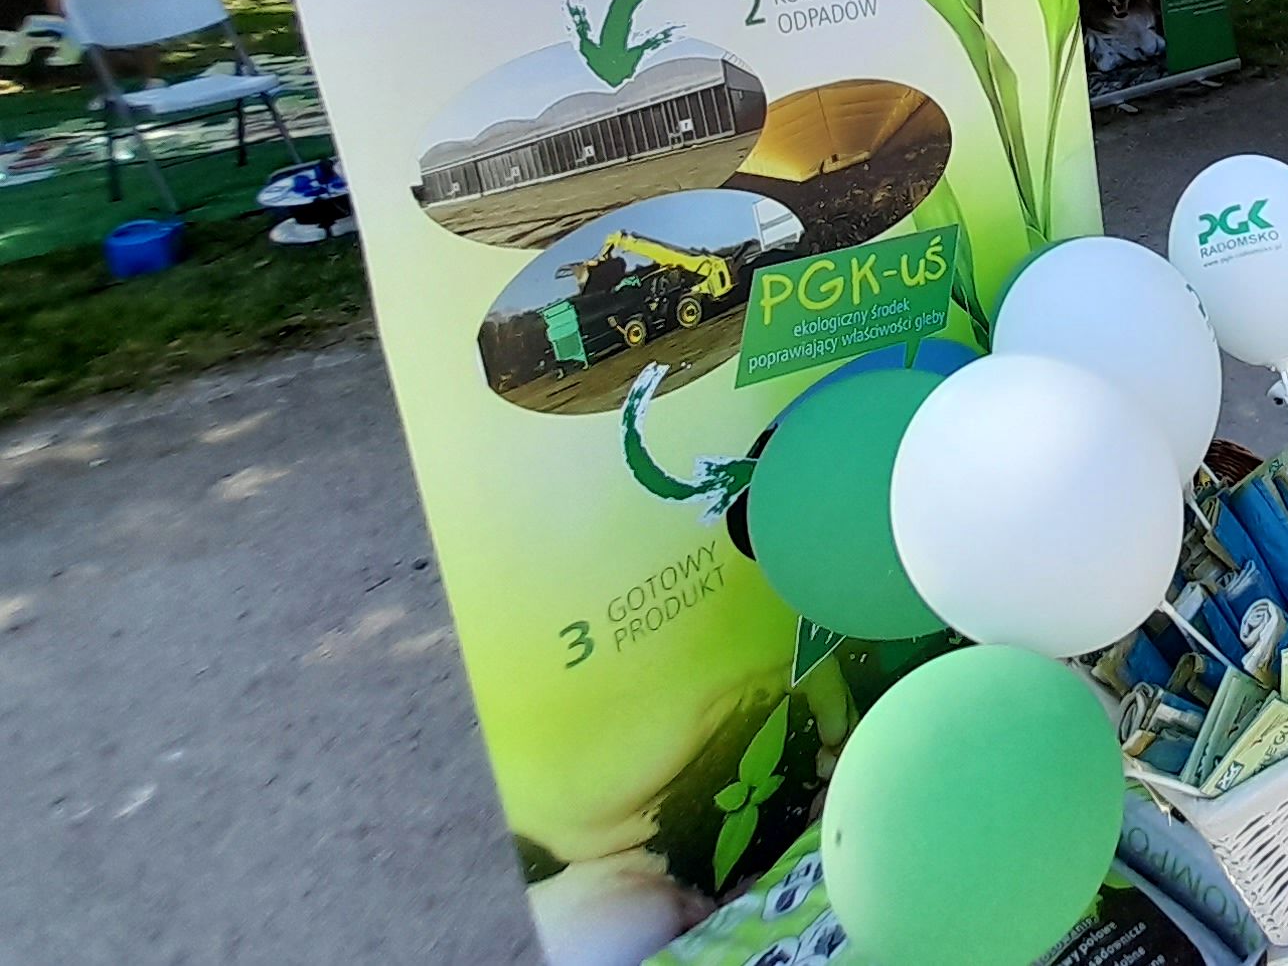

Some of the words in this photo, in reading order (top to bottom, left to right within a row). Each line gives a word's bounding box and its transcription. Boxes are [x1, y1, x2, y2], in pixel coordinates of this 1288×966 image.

[1197, 198, 1275, 246] PGK
[1200, 230, 1280, 258] RADOMSKO
[760, 235, 947, 326] PGK-uś
[748, 336, 838, 374] poprawiający
[841, 315, 913, 346] właściwości
[914, 309, 946, 332] gleby
[794, 308, 869, 337] ekologiczny
[871, 298, 911, 320] środek
[607, 540, 716, 623] GOTOWY
[614, 563, 725, 653] PRODUKT
[559, 620, 595, 669] 3
